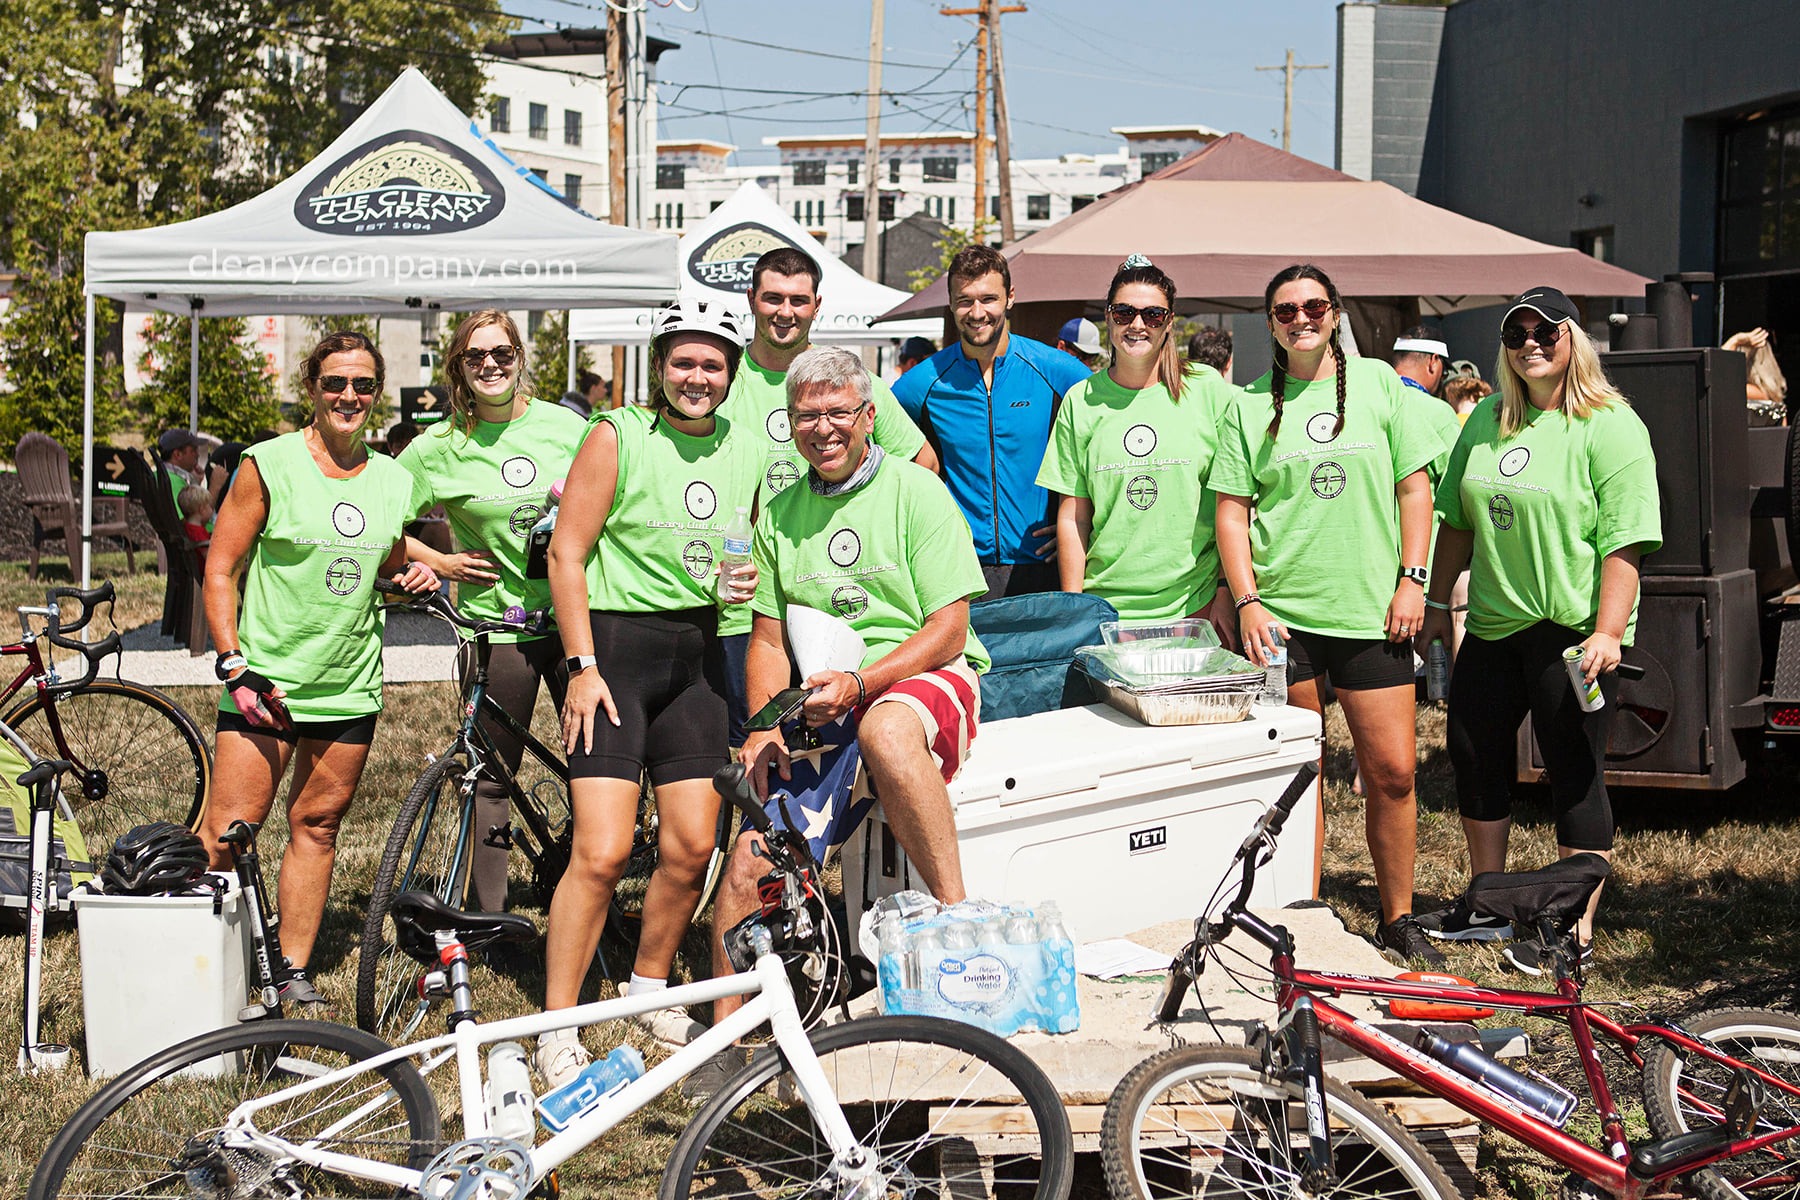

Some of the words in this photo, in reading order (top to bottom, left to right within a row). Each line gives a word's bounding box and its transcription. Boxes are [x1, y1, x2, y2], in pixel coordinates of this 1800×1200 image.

[309, 195, 370, 214] THE
[378, 191, 491, 213] CLEARY
[316, 206, 477, 225] COMPANY
[355, 222, 386, 232] EST
[188, 248, 577, 286] clearycompany.com
[695, 263, 737, 276] THE
[1127, 459, 1150, 467] Club
[646, 519, 685, 530] Cleary
[294, 536, 332, 547] Cleary
[335, 538, 357, 548] Club
[796, 570, 829, 584] Cleary
[1131, 828, 1164, 848] YETI
[963, 974, 1001, 983] Drinking
[976, 982, 1001, 990] Water
